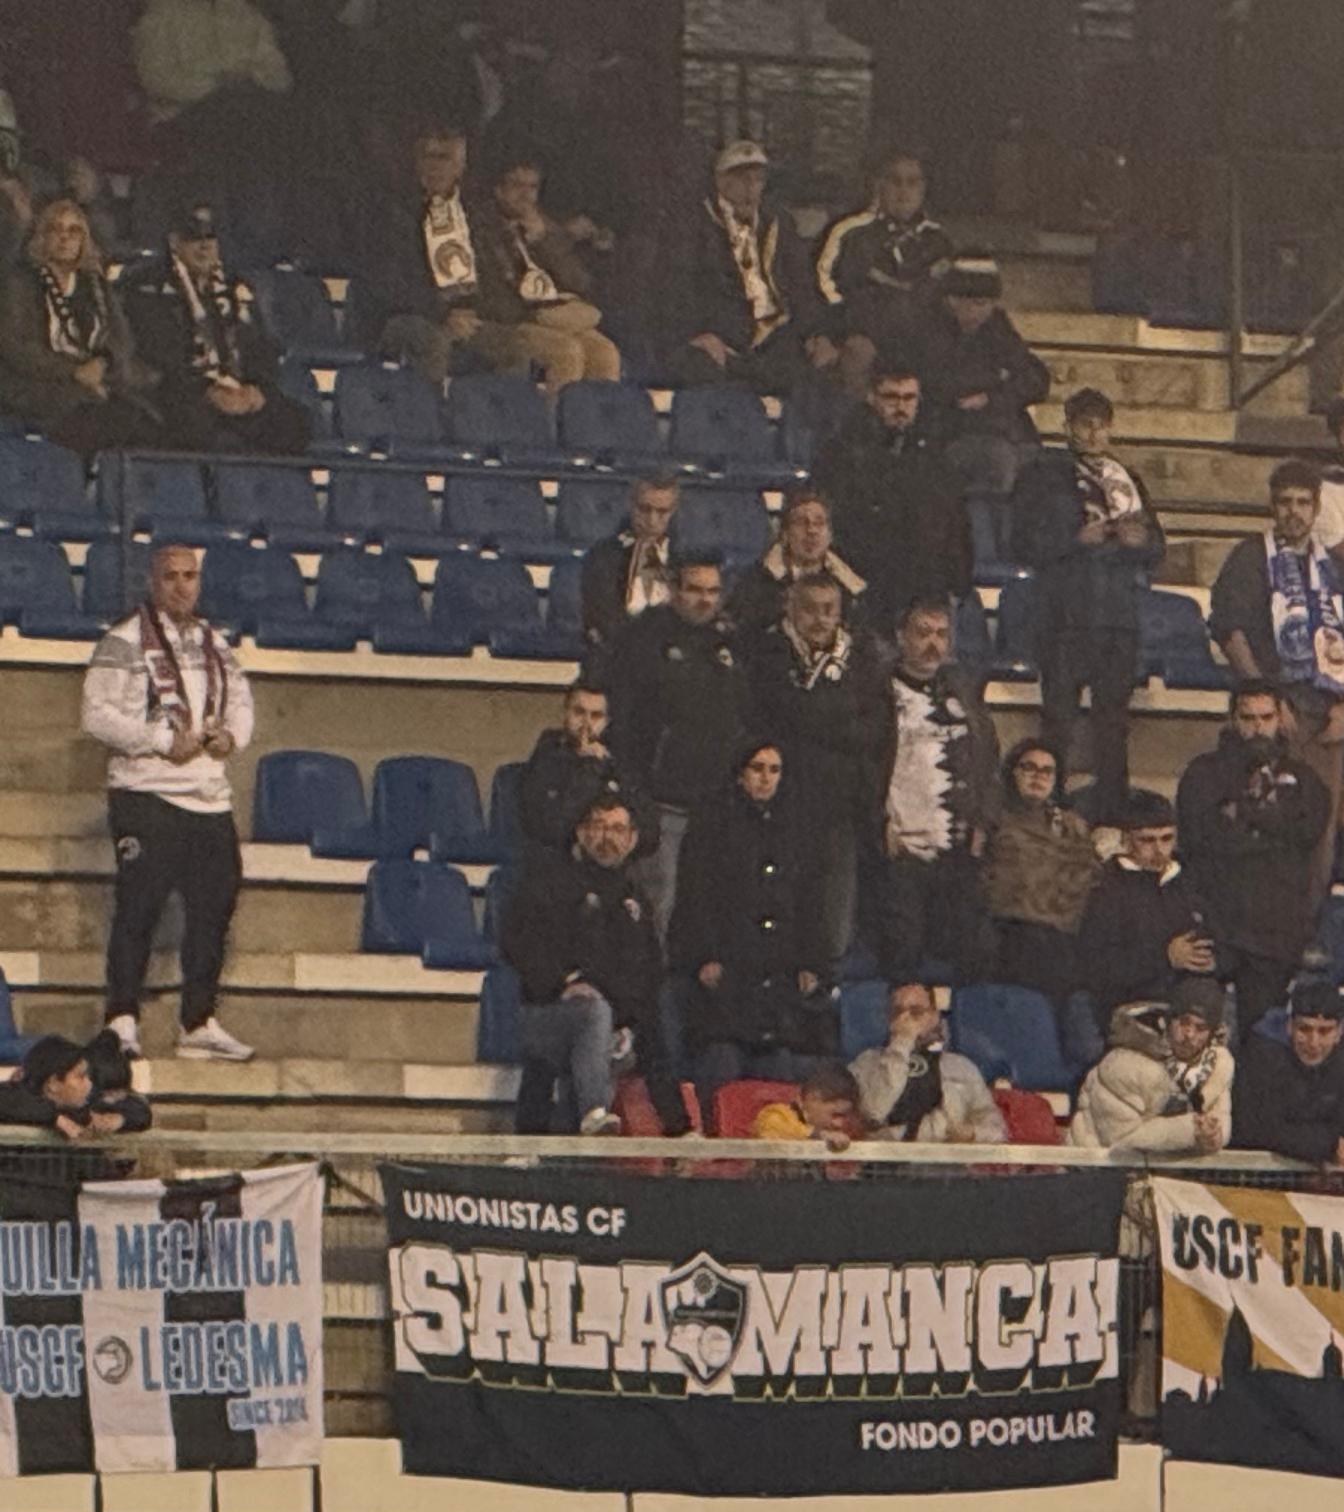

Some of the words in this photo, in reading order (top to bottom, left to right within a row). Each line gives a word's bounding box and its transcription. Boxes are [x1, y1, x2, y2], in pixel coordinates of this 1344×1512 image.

[115, 1202, 301, 1293] MECÁNICA
[403, 1191, 580, 1235] UNIONISTAS
[587, 1206, 626, 1237] CF
[1171, 1211, 1267, 1286] USCF
[139, 1320, 308, 1394] LEDESMA
[400, 1240, 1108, 1400] SALAMANCA
[861, 1420, 962, 1451] FONDO
[970, 1410, 1095, 1449] POPULAR
